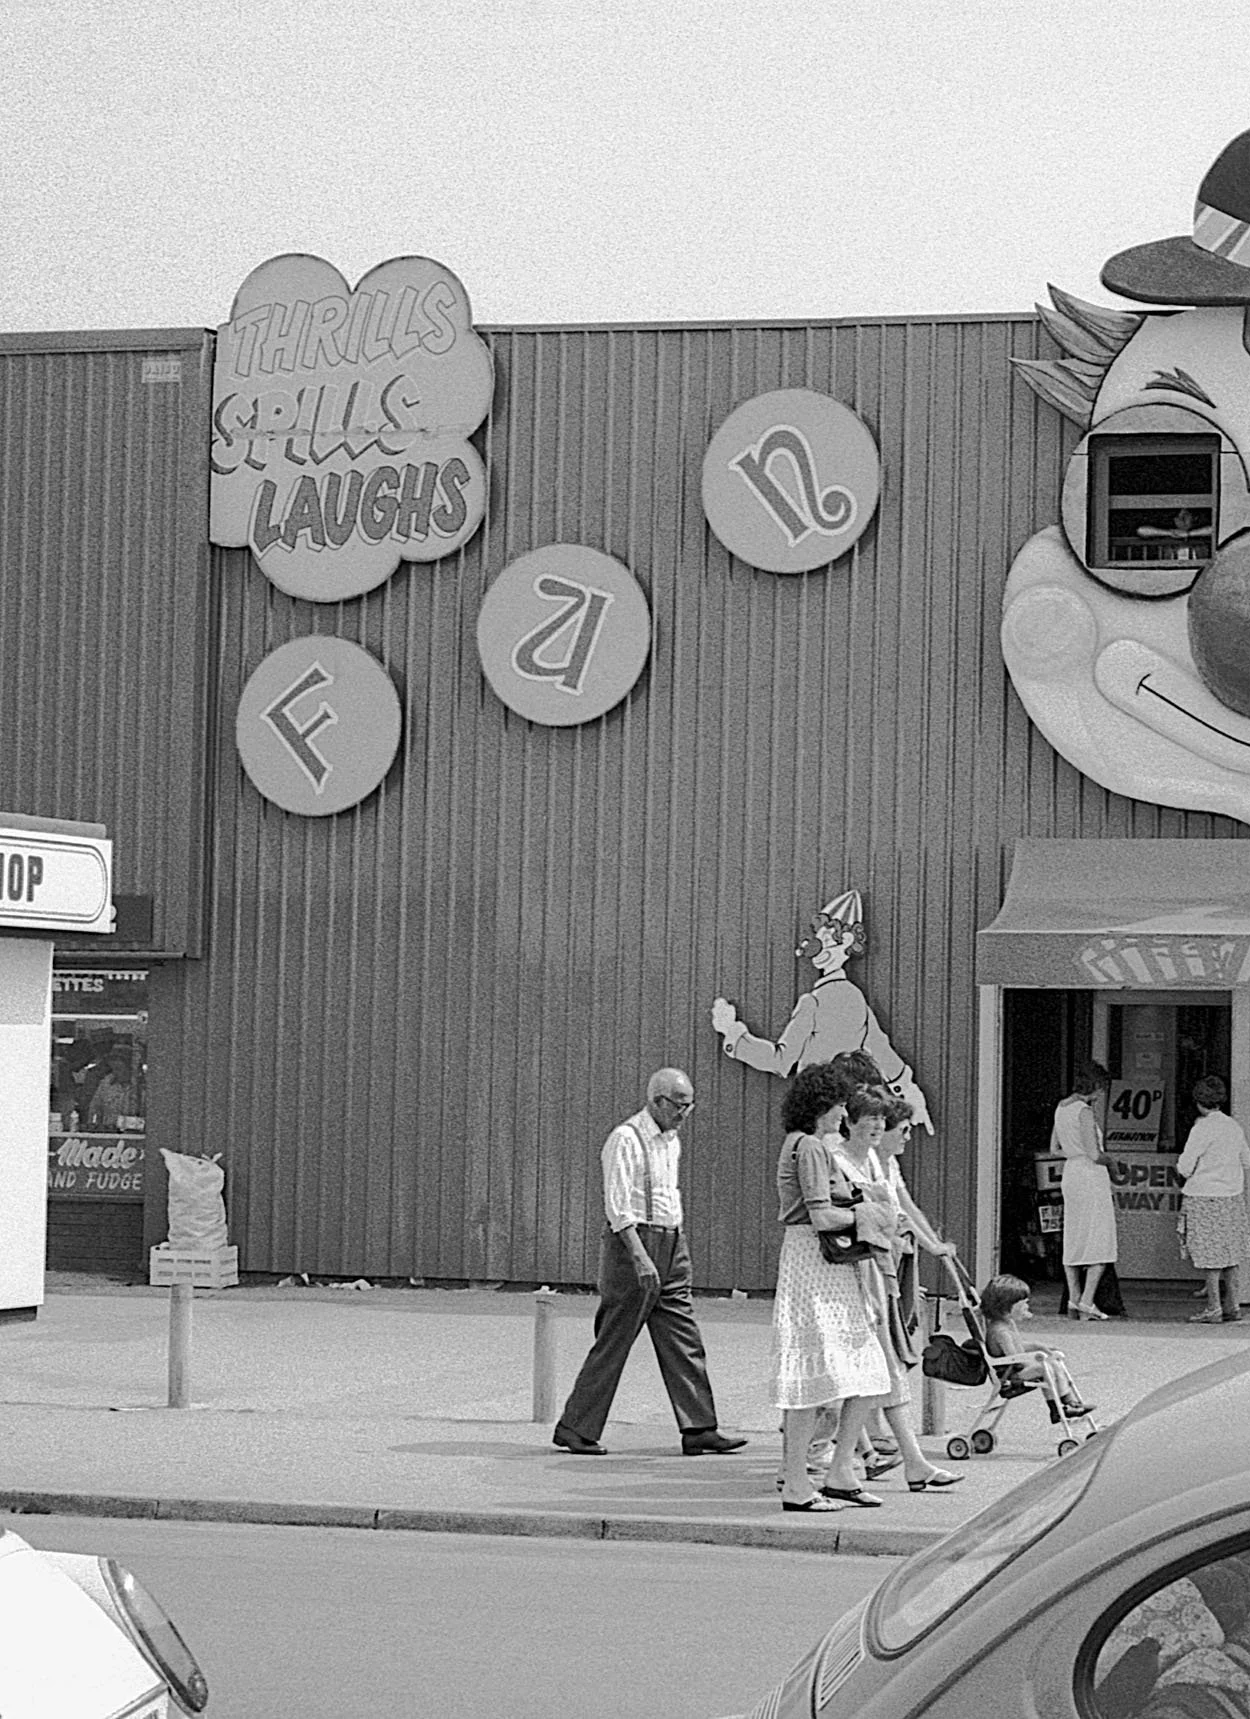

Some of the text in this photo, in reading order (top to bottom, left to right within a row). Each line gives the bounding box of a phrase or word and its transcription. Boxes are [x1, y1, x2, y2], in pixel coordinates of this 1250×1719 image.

[231, 281, 458, 378] THRILLS
[210, 374, 421, 475] SPILLS
[250, 457, 471, 560] LAUGHS
[86, 1171, 142, 1190] FUDGE
[1116, 1191, 1164, 1210] WAY
